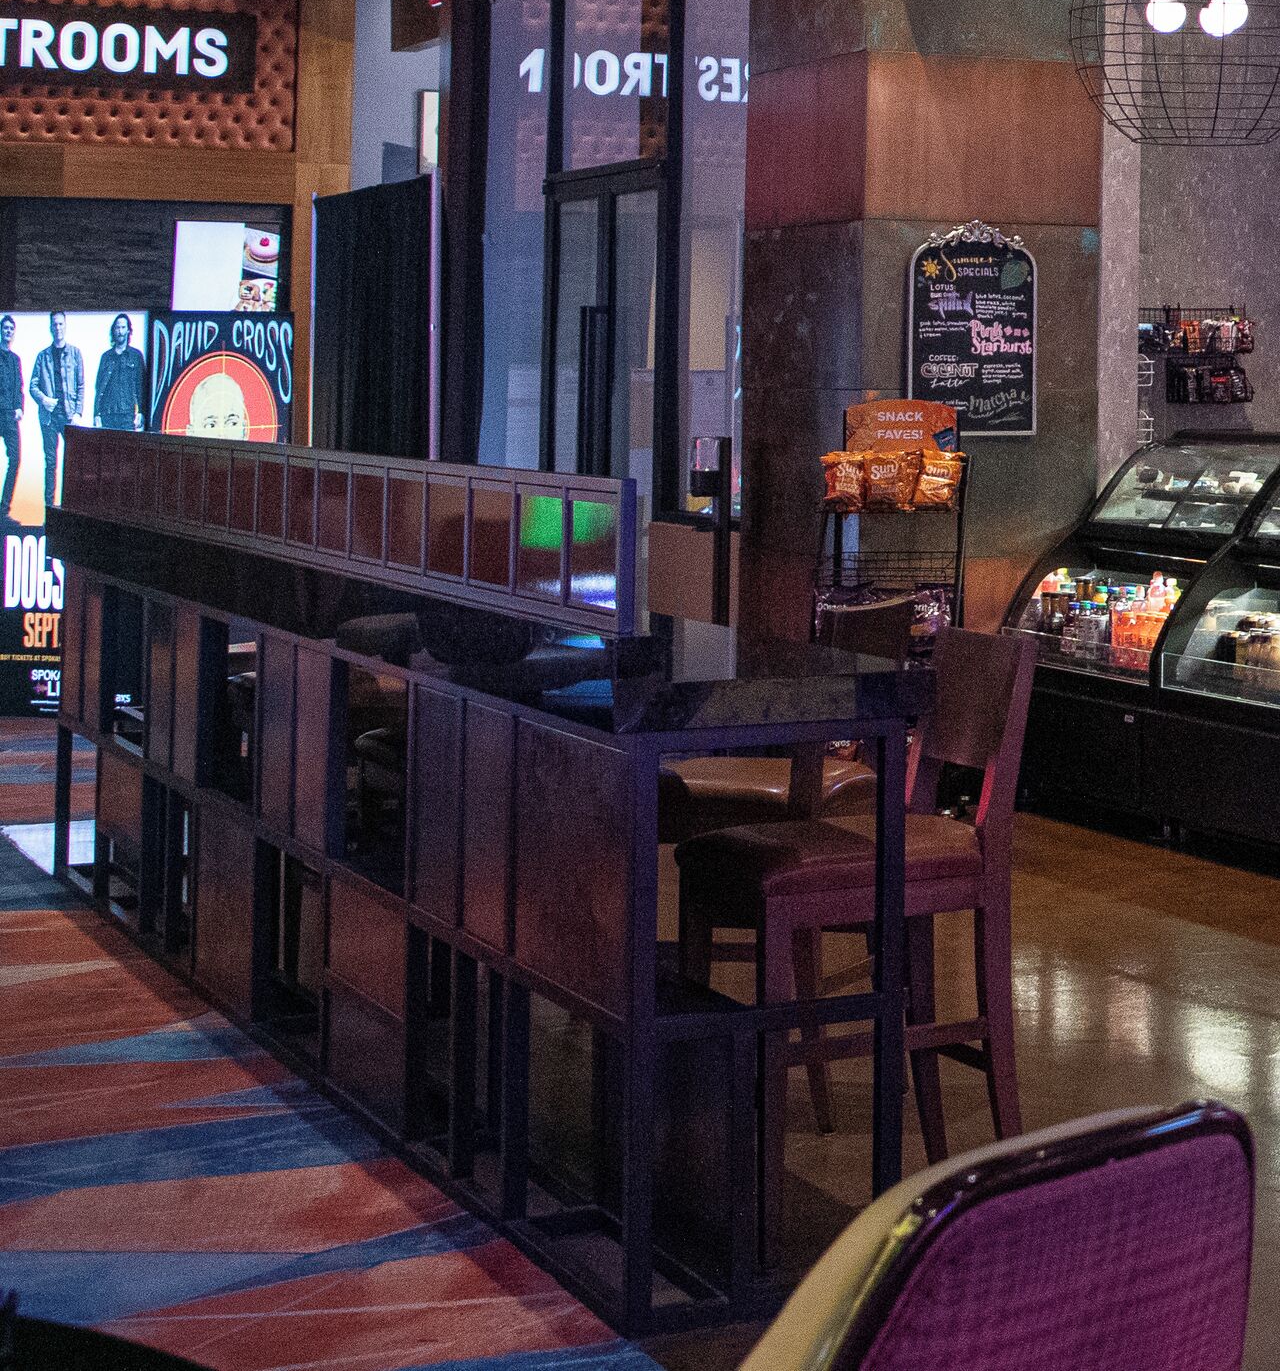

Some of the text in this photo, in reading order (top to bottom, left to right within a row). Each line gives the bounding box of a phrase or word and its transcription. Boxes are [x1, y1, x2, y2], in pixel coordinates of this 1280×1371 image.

[958, 267, 999, 277] SPECIALS
[969, 319, 1004, 341] Pink
[971, 336, 1032, 356] Starburst
[150, 319, 293, 418] DAVID CROSS
[877, 412, 923, 422] SNACK
[877, 429, 923, 439] FAVES!
